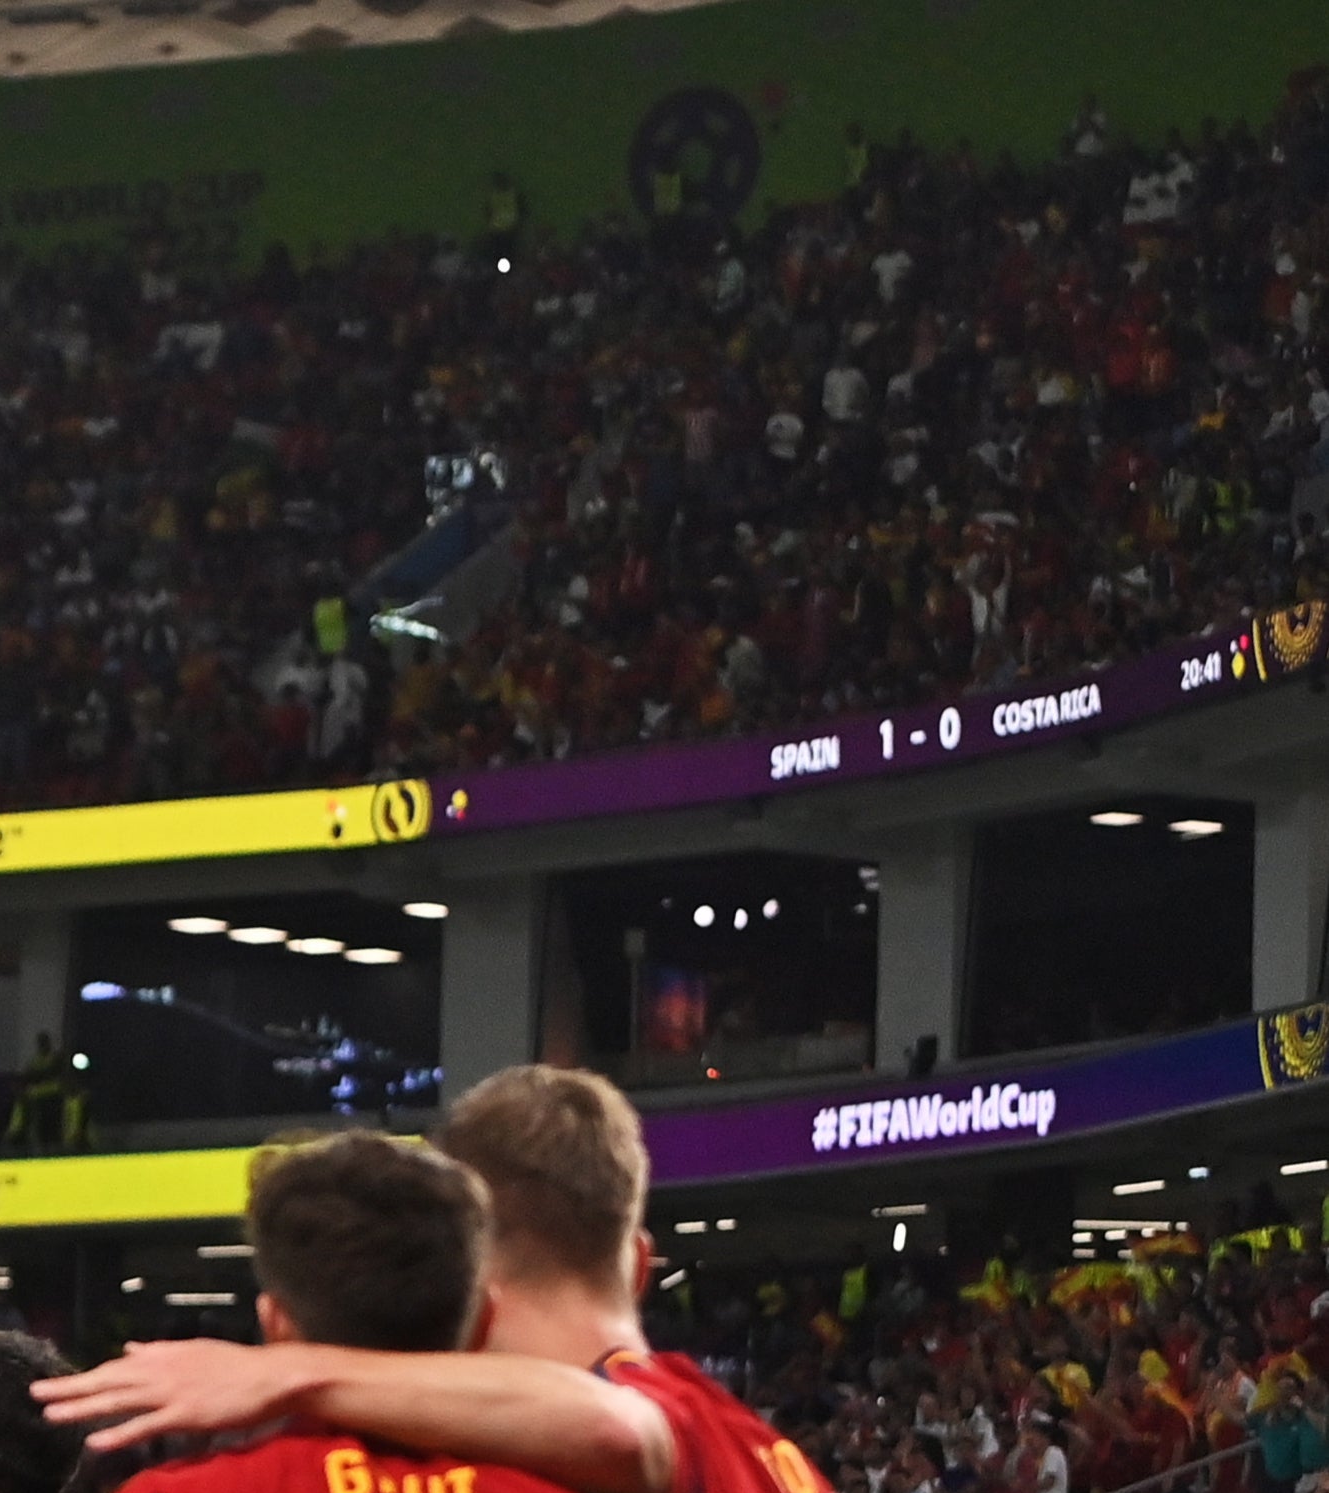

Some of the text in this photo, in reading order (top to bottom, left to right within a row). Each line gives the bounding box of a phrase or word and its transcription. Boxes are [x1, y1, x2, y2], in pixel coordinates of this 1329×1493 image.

[770, 736, 840, 780] SPAIN
[879, 719, 894, 760] 1
[940, 707, 962, 751] 0
[993, 693, 1059, 737] COSTA
[1058, 683, 1102, 723] RICA
[1180, 651, 1221, 691] 20:41
[812, 1082, 1056, 1151] #FIFAWorldCup
